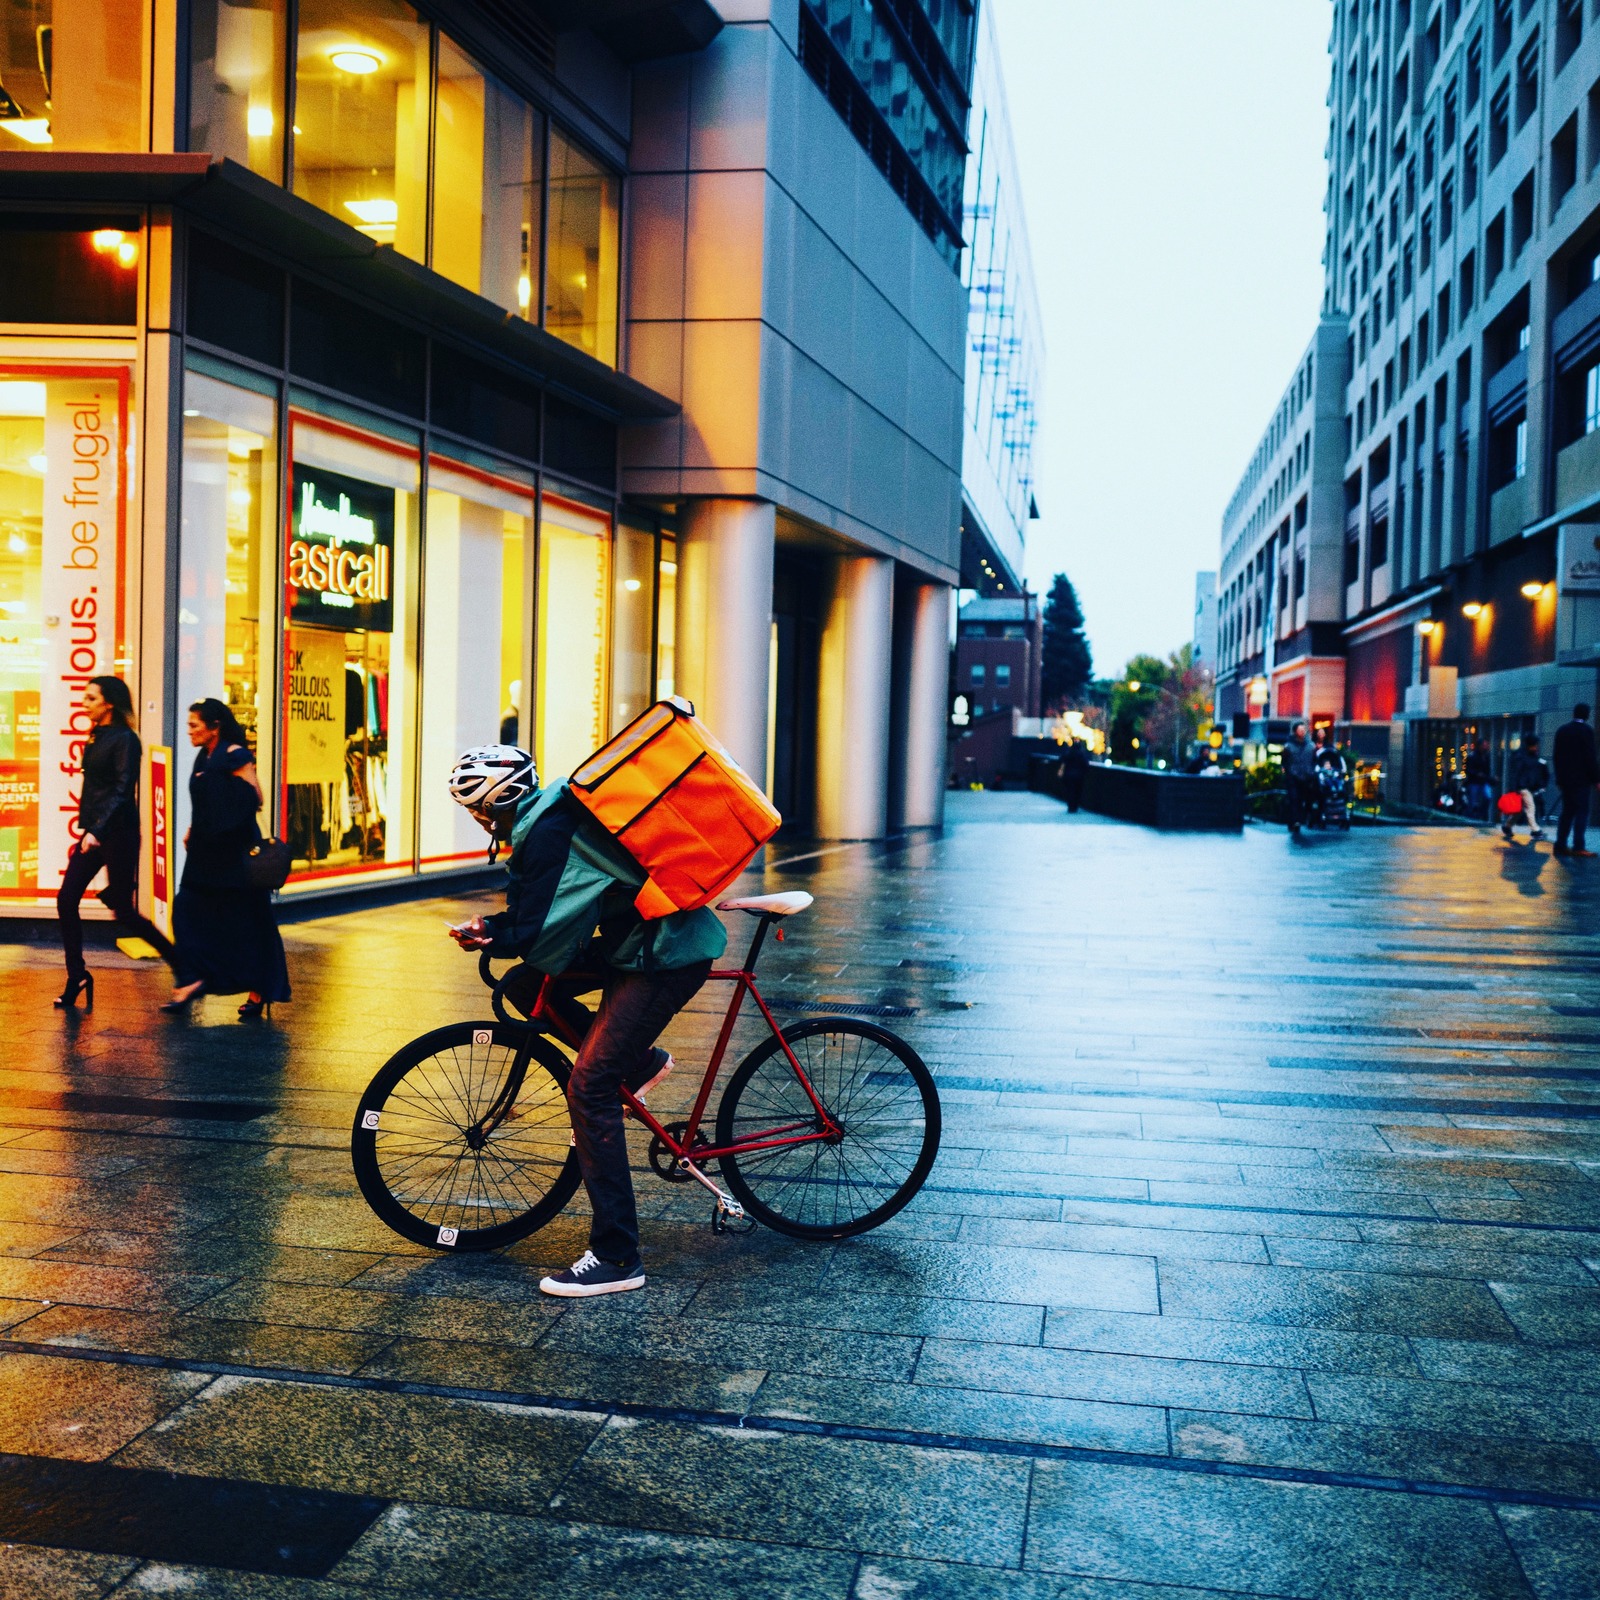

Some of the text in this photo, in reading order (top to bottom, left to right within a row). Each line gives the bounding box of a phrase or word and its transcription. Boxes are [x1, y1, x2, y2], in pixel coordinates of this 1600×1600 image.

[64, 394, 109, 508] frugal.
[63, 520, 98, 570] be
[60, 587, 98, 778] fabulous.
[291, 700, 336, 722] FRUGAL.
[154, 786, 165, 878] SALE
